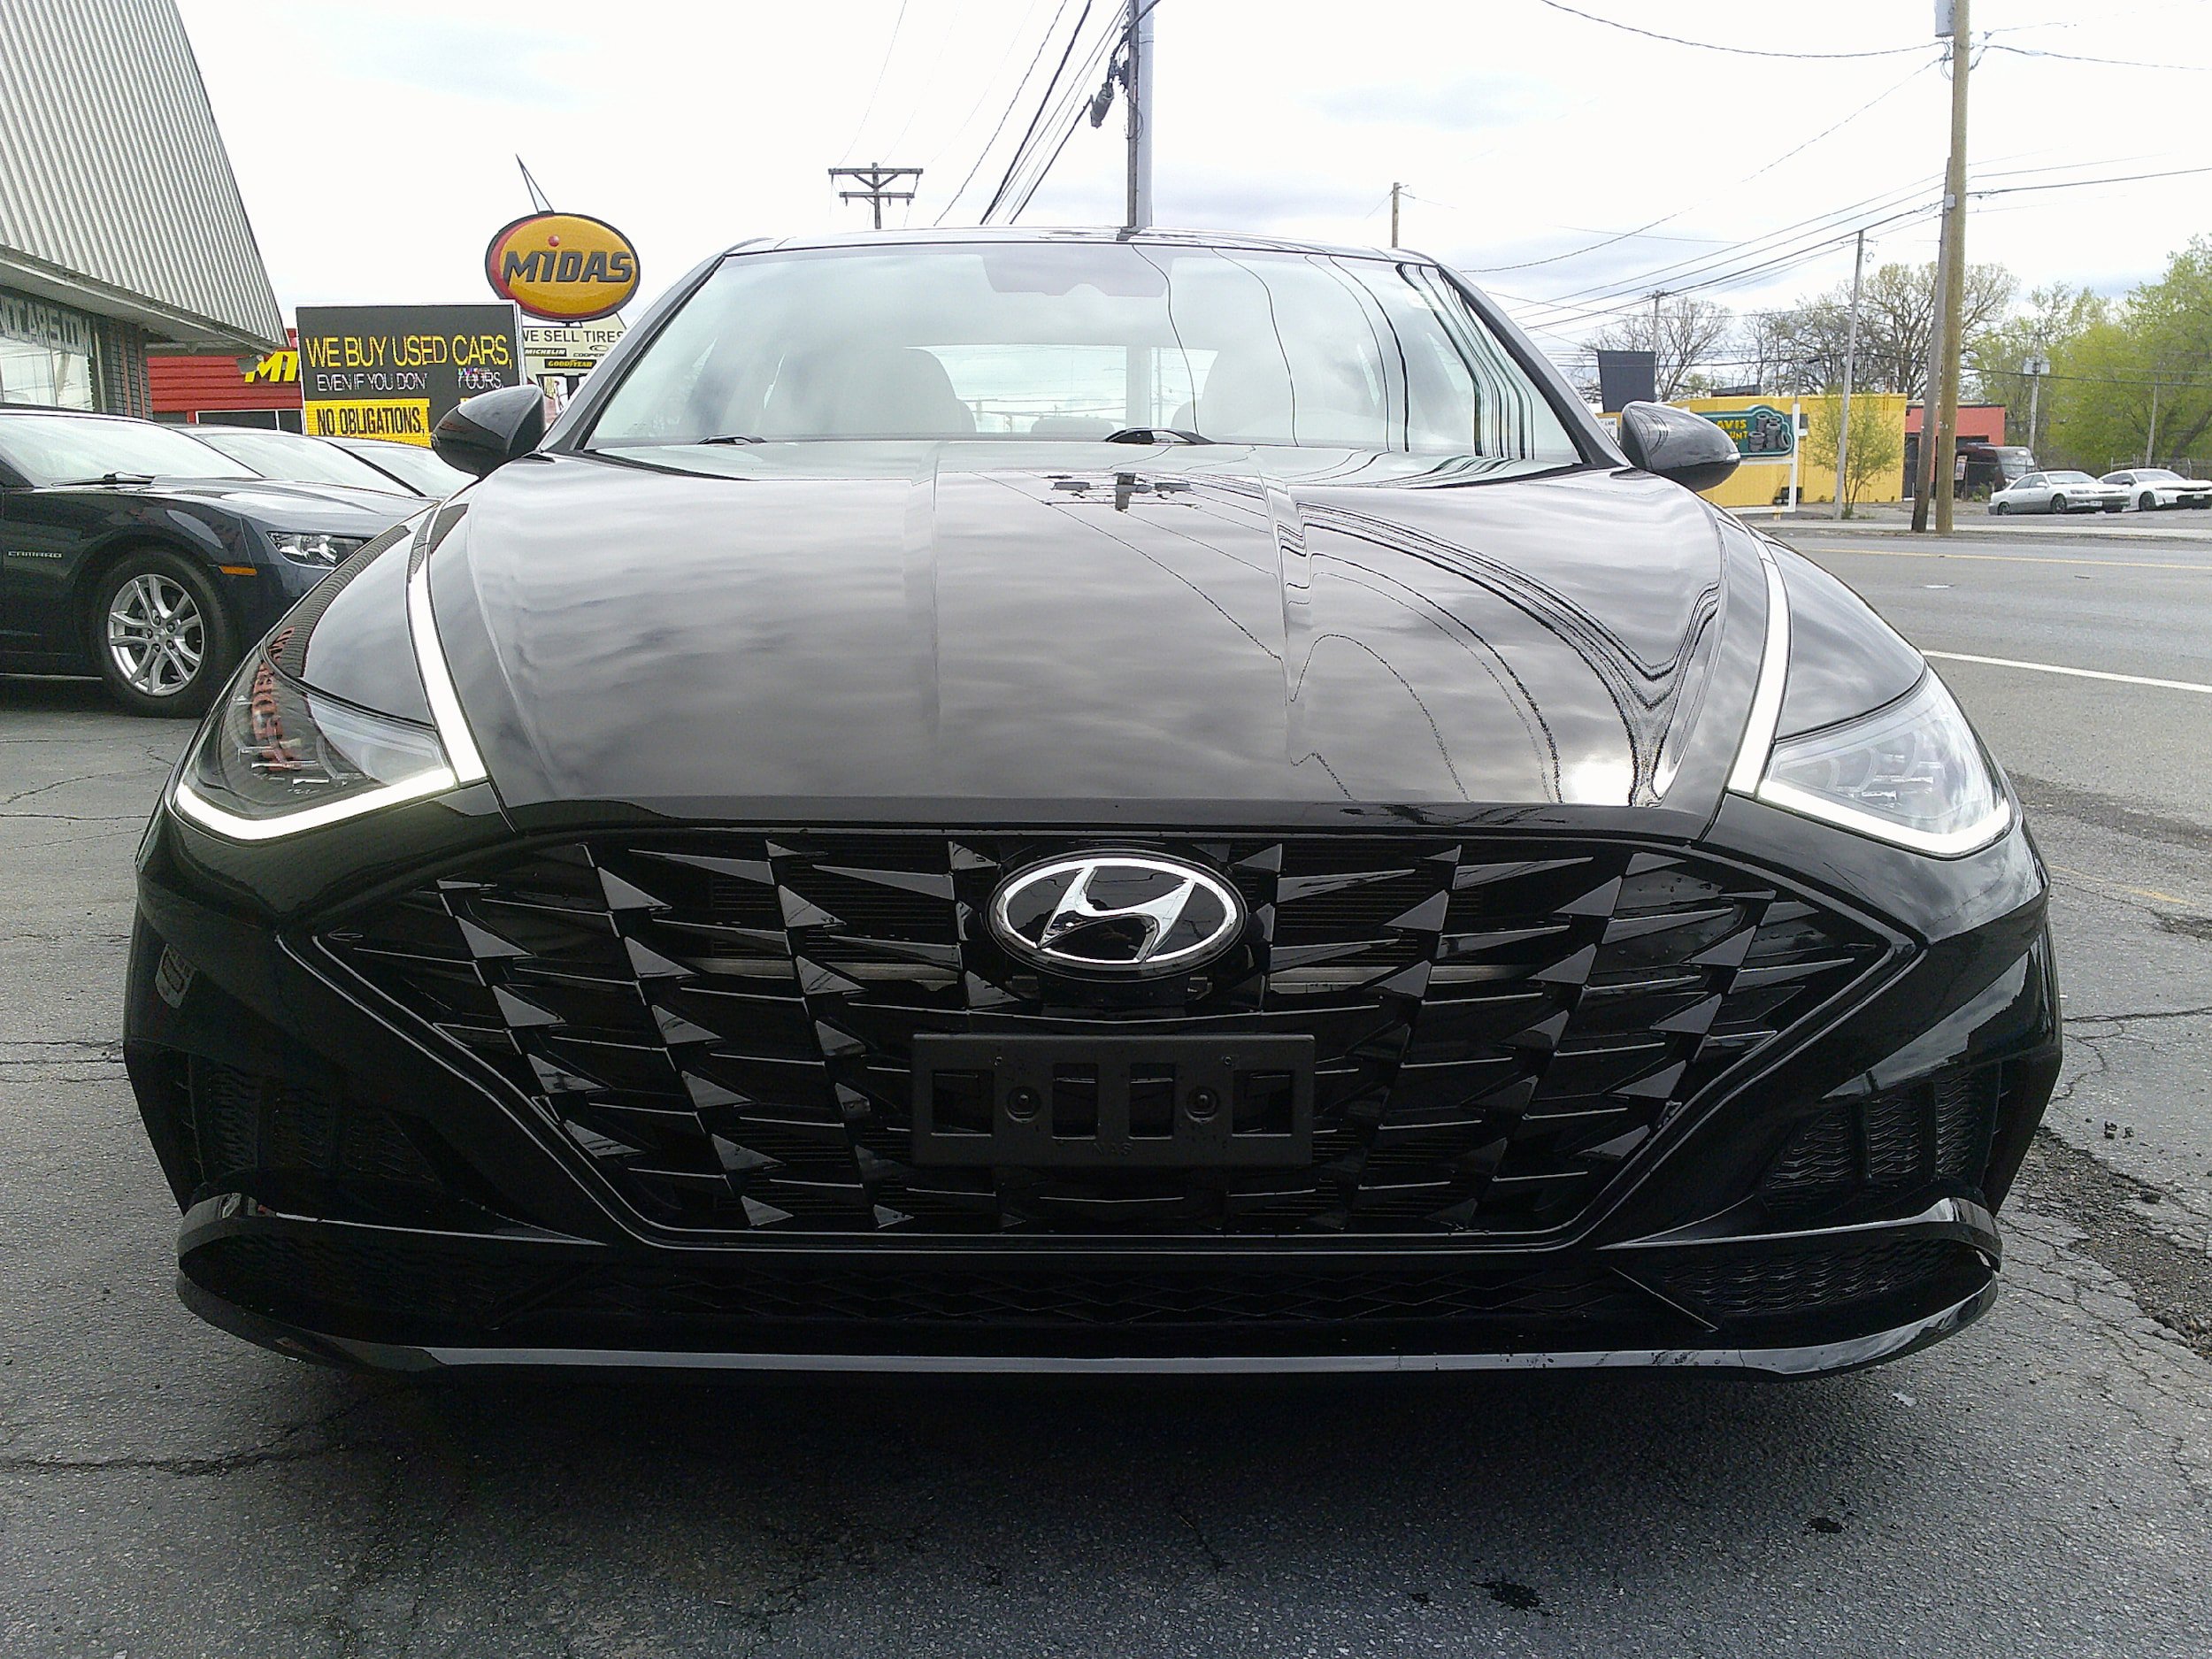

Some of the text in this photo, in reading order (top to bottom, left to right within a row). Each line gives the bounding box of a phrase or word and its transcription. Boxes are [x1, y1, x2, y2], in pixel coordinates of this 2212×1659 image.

[503, 250, 632, 286] MIDAS
[544, 331, 580, 342] SELL
[583, 331, 624, 342] TIRES
[305, 334, 513, 370] WE BUY USED CARS,
[548, 359, 593, 368] GOODYEAR
[317, 373, 351, 391] EVEN
[353, 373, 365, 390] IF
[366, 373, 395, 390] YOU
[316, 408, 335, 436] NO
[339, 406, 425, 437] OBLIGATIONS,
